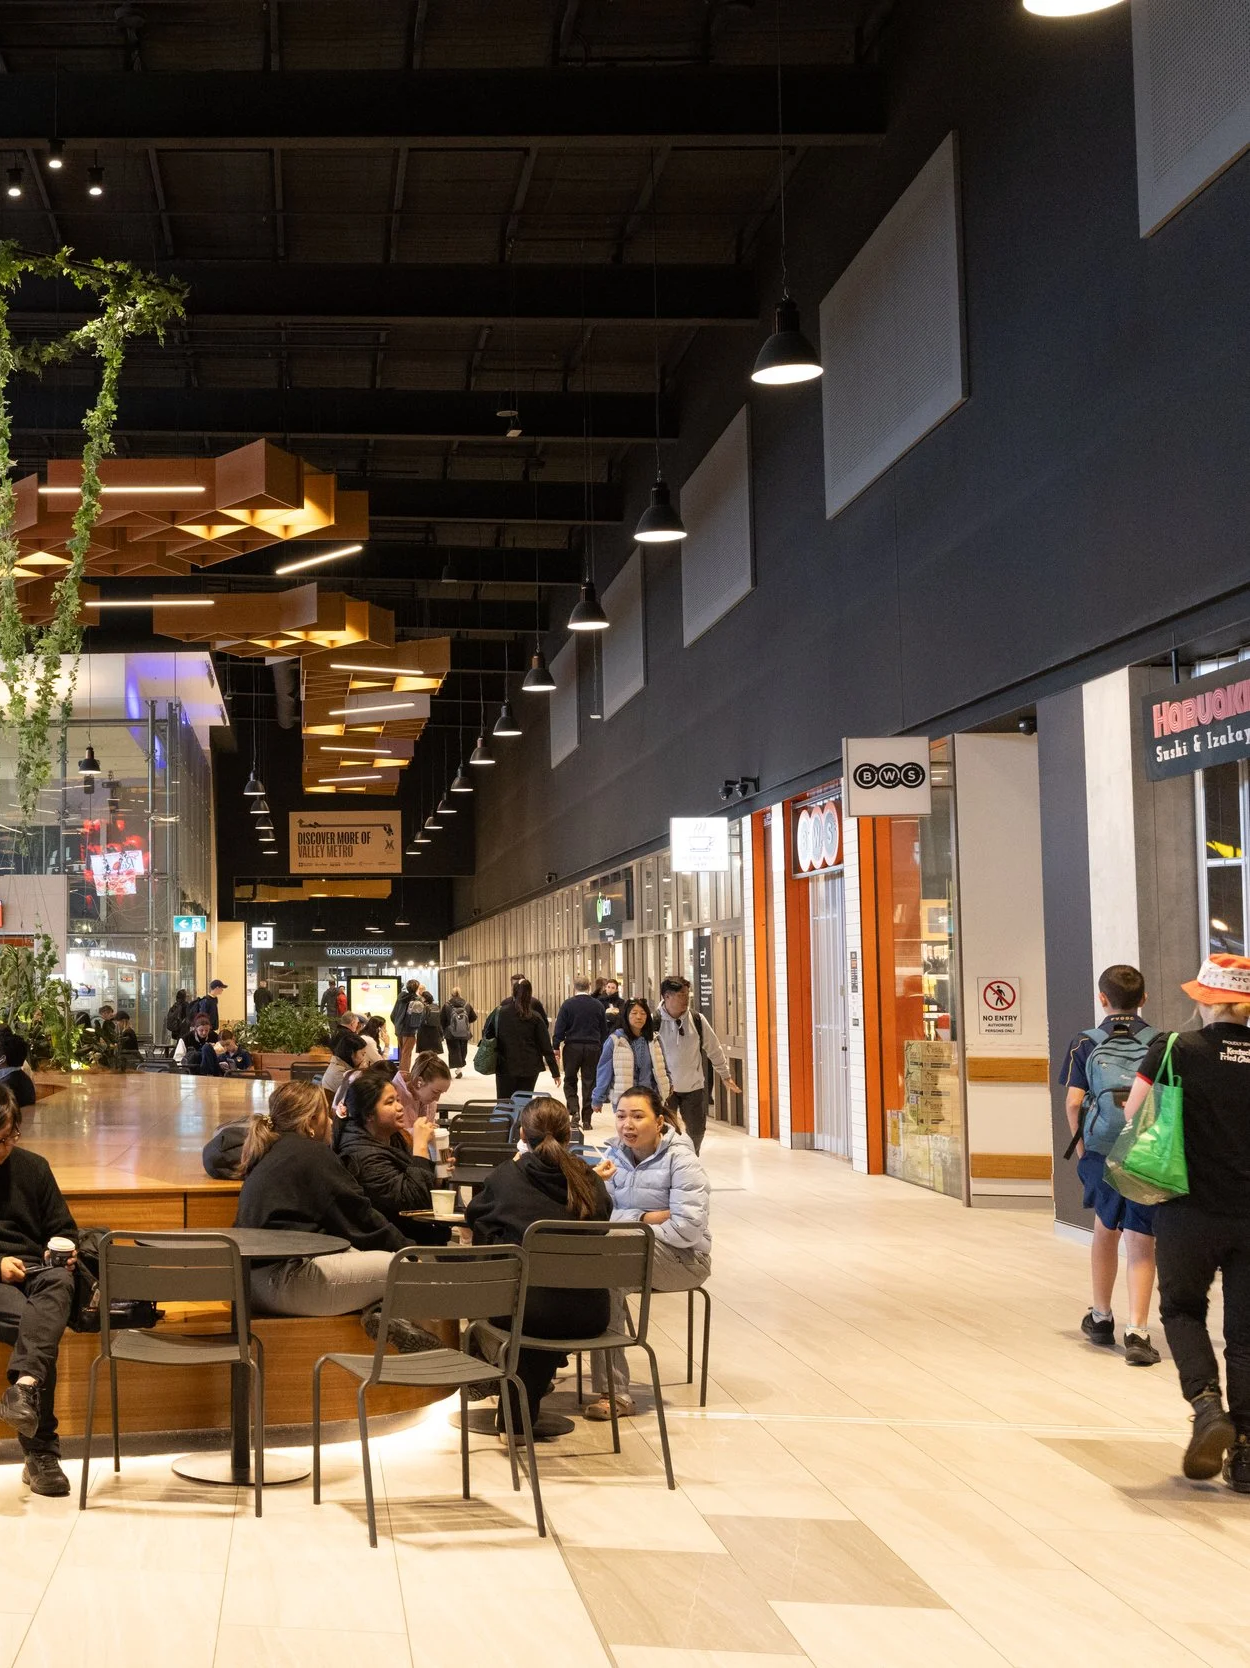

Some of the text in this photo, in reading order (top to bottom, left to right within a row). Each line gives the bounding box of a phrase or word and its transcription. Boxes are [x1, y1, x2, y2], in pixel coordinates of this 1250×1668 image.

[1156, 740, 1188, 762] Sushi
[1193, 734, 1201, 752] &
[297, 831, 371, 845] DISCOVER MORE OF
[298, 845, 353, 858] VALLEY METRO
[1219, 1052, 1237, 1062] Fried
